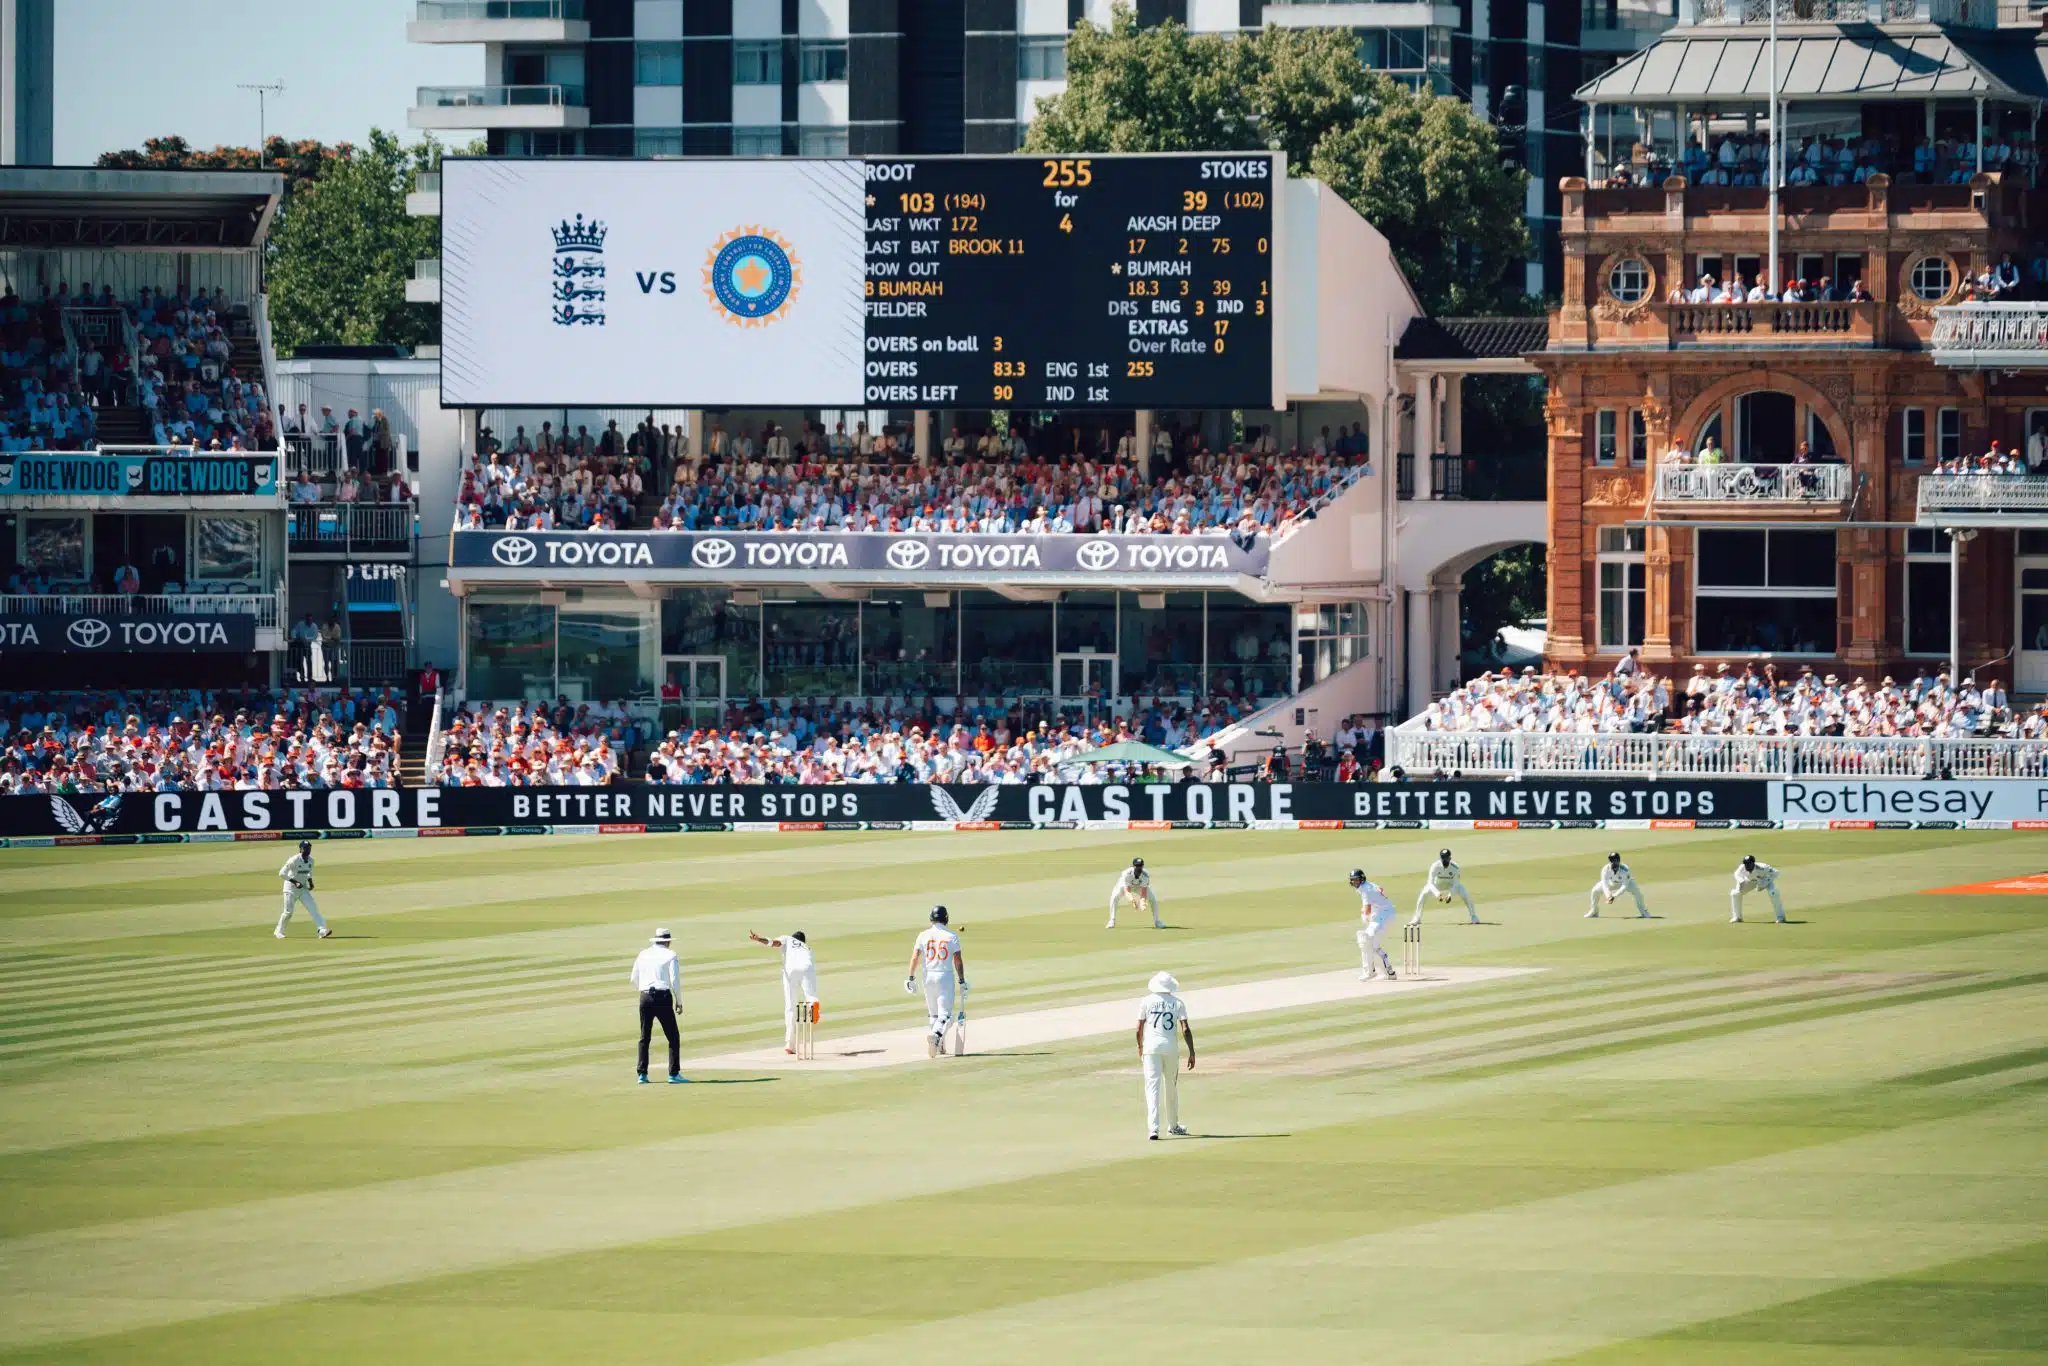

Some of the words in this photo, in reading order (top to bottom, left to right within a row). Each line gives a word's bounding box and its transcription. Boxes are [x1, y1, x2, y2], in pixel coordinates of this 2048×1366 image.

[865, 164, 915, 181] ROOT
[1043, 160, 1091, 186] 255
[1201, 161, 1267, 178] STOKES
[900, 193, 934, 212] 103
[945, 194, 985, 210] (194)
[1055, 191, 1078, 207] for
[1184, 191, 1207, 210] 39
[865, 218, 900, 231] LAST
[909, 218, 941, 231] WKT
[952, 216, 977, 231] 172
[1060, 214, 1072, 232] 4
[1127, 216, 1176, 231] AKASH
[1182, 216, 1221, 231] DEEP
[865, 241, 900, 254] LAST
[911, 241, 939, 254] BAT
[950, 239, 1002, 254] BROOK
[1009, 240, 1024, 254] 11
[1130, 239, 1145, 254] 17
[1180, 239, 1187, 253] 2
[1213, 239, 1230, 253] 75
[1258, 238, 1267, 252] 0
[865, 262, 900, 275] HOW
[909, 262, 940, 275] OUT
[1128, 261, 1191, 276] BUMRAH
[865, 282, 874, 296] B
[879, 281, 942, 296] BUMRAH
[1129, 281, 1158, 295] 18.3
[1181, 281, 1188, 295] 3
[1213, 280, 1230, 295] 39
[1261, 281, 1267, 295] 1
[865, 302, 927, 317] FIELDER
[1109, 301, 1138, 315] DRS
[1152, 300, 1180, 313] ENG
[1196, 301, 1204, 315] 3
[1217, 300, 1243, 313] IND
[1256, 300, 1264, 315] 3
[1129, 320, 1188, 335] EXTRAS
[1215, 320, 1228, 335] 17
[866, 337, 917, 352] OVERS
[922, 340, 942, 351] on
[947, 336, 979, 351] ball
[994, 336, 1002, 351] 3
[1129, 339, 1166, 353] Over
[1171, 338, 1206, 352] Rate
[1215, 339, 1224, 353] 0
[866, 362, 917, 377] OVERS
[994, 362, 1025, 376] 83.3
[1046, 362, 1077, 377] ENG
[1088, 363, 1109, 377] 1st
[1128, 362, 1153, 376] 255
[866, 386, 918, 401] OVERS
[922, 386, 958, 401] LEFT
[994, 386, 1012, 400] 90
[1046, 386, 1074, 401] IND
[1088, 387, 1109, 401] 1st
[19, 460, 119, 491] BREWDOG
[150, 461, 248, 491] BREWDOG
[545, 541, 654, 565] TOYOTA
[744, 542, 849, 565] TOYOTA
[937, 543, 1040, 567] TOYOTA
[1127, 544, 1229, 568] TOYOTA
[120, 623, 228, 645] TOYOTA
[154, 788, 441, 831] CASTORE
[513, 794, 631, 818] BETTER
[648, 793, 745, 817] NEVER
[761, 793, 858, 817] STOPS
[1028, 784, 1294, 822] CASTORE
[1354, 791, 1472, 815] BETTER
[1489, 791, 1592, 815] NEVER
[1610, 791, 1714, 815] STOPS
[1783, 783, 1993, 820] Rothesay
[926, 939, 949, 961] 55
[1150, 1011, 1174, 1031] 73
